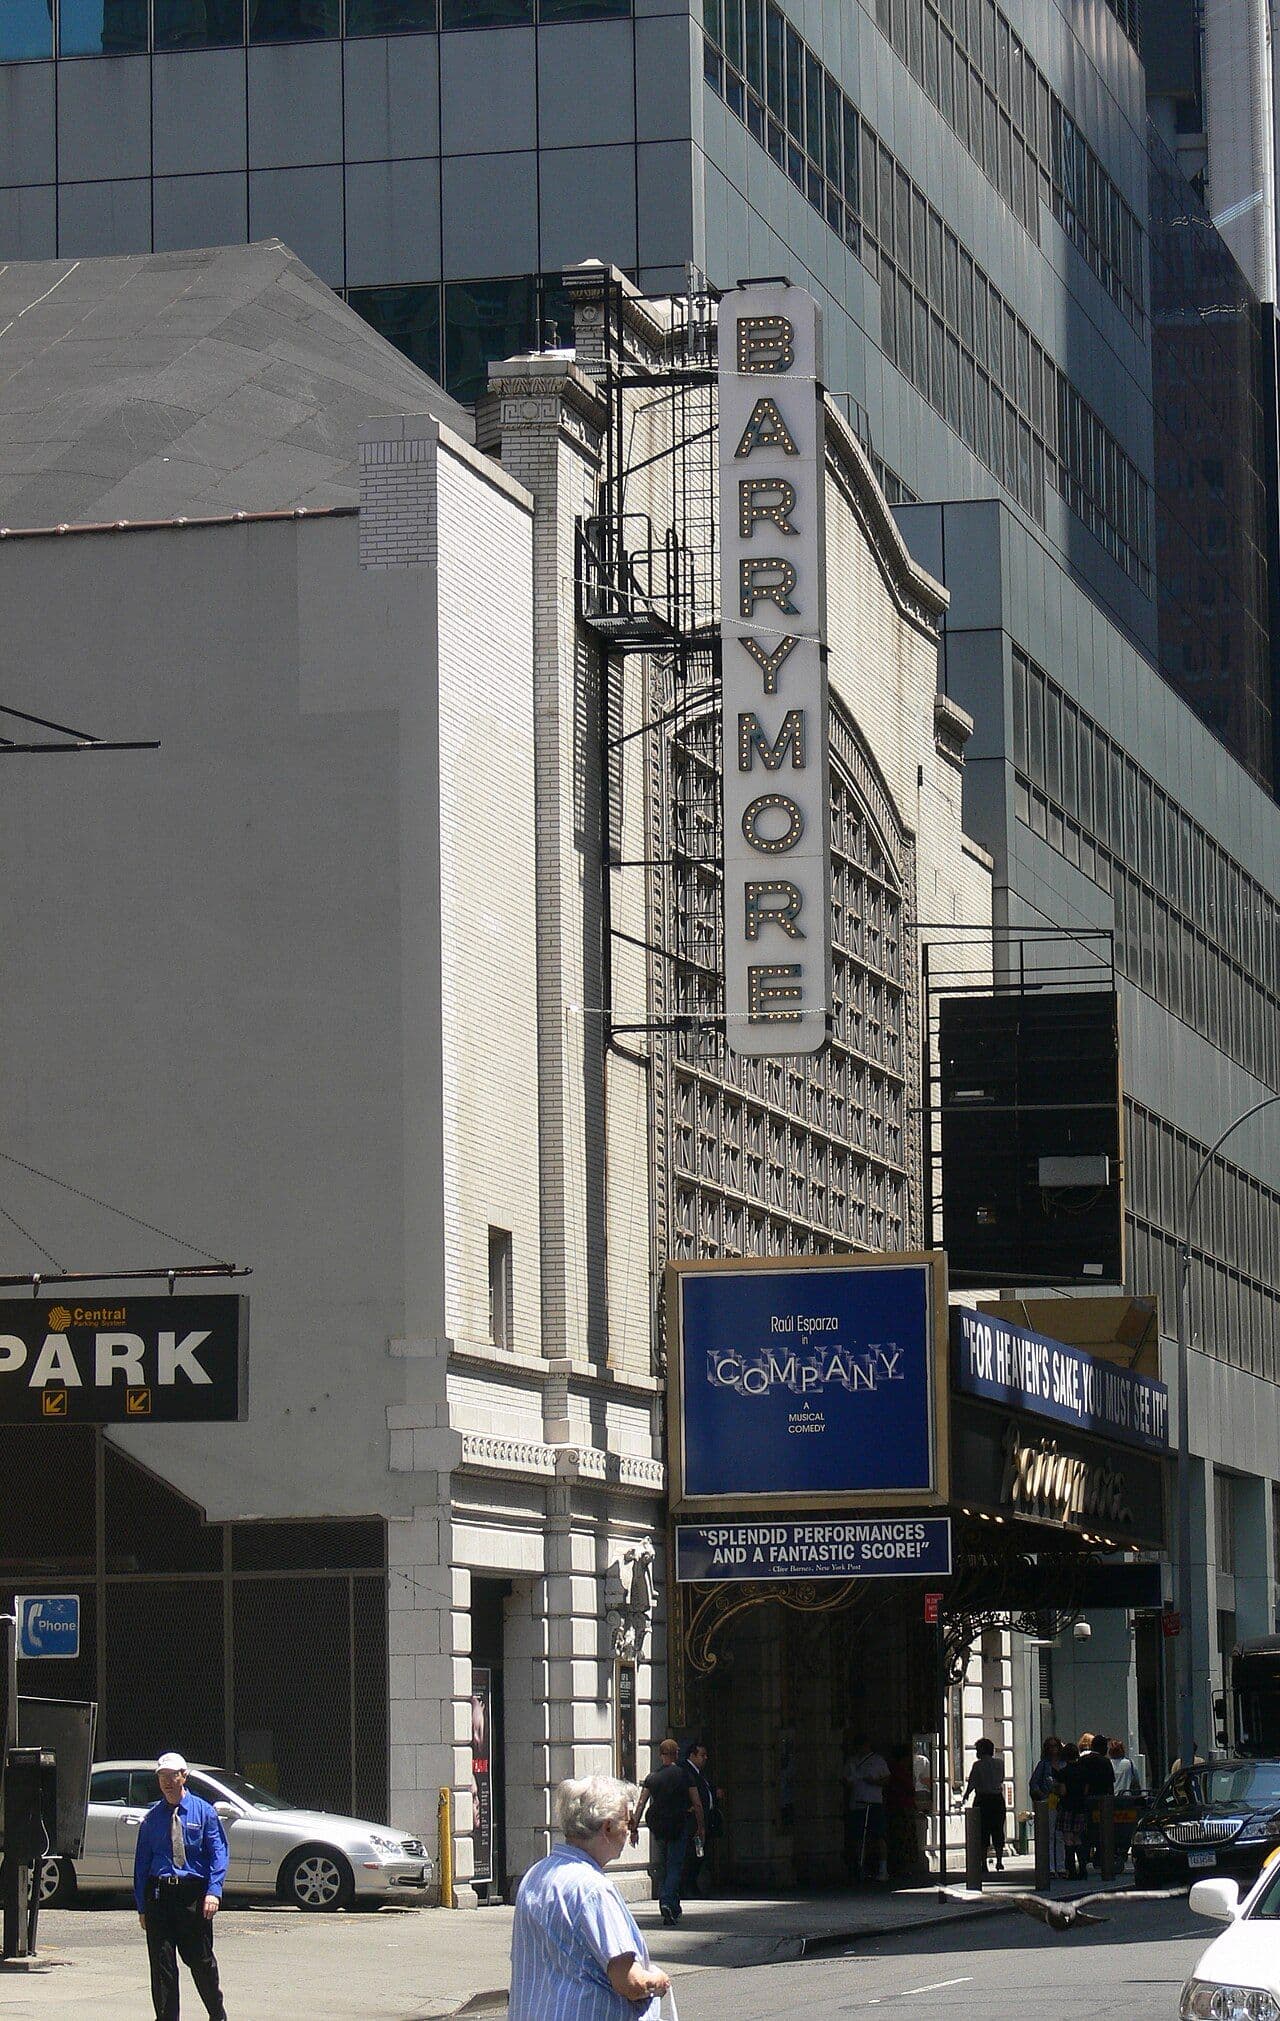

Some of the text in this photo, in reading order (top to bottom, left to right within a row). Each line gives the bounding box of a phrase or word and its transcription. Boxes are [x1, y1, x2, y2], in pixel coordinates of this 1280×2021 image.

[734, 315, 807, 1025] BARRYMORE
[74, 1307, 126, 1320] Central
[771, 1315, 839, 1335] Raúl Esparza
[801, 1334, 809, 1345] in
[0, 1330, 214, 1388] PARK
[715, 1352, 900, 1394] COMPANY
[996, 1329, 1049, 1399] HEAVEN'S
[1052, 1350, 1082, 1418] SAKE,
[1082, 1362, 1102, 1419] YOU
[1105, 1373, 1131, 1427] MUST
[1133, 1381, 1150, 1434] SEE
[803, 1401, 810, 1410] A
[788, 1412, 825, 1422] MUSICAL
[788, 1423, 826, 1433] COMEDY
[699, 1523, 926, 1546] “SPLENDID PERFORMANCES
[712, 1541, 930, 1564] AND A FANTASTIC SCORE!”
[38, 1620, 77, 1632] Phone
